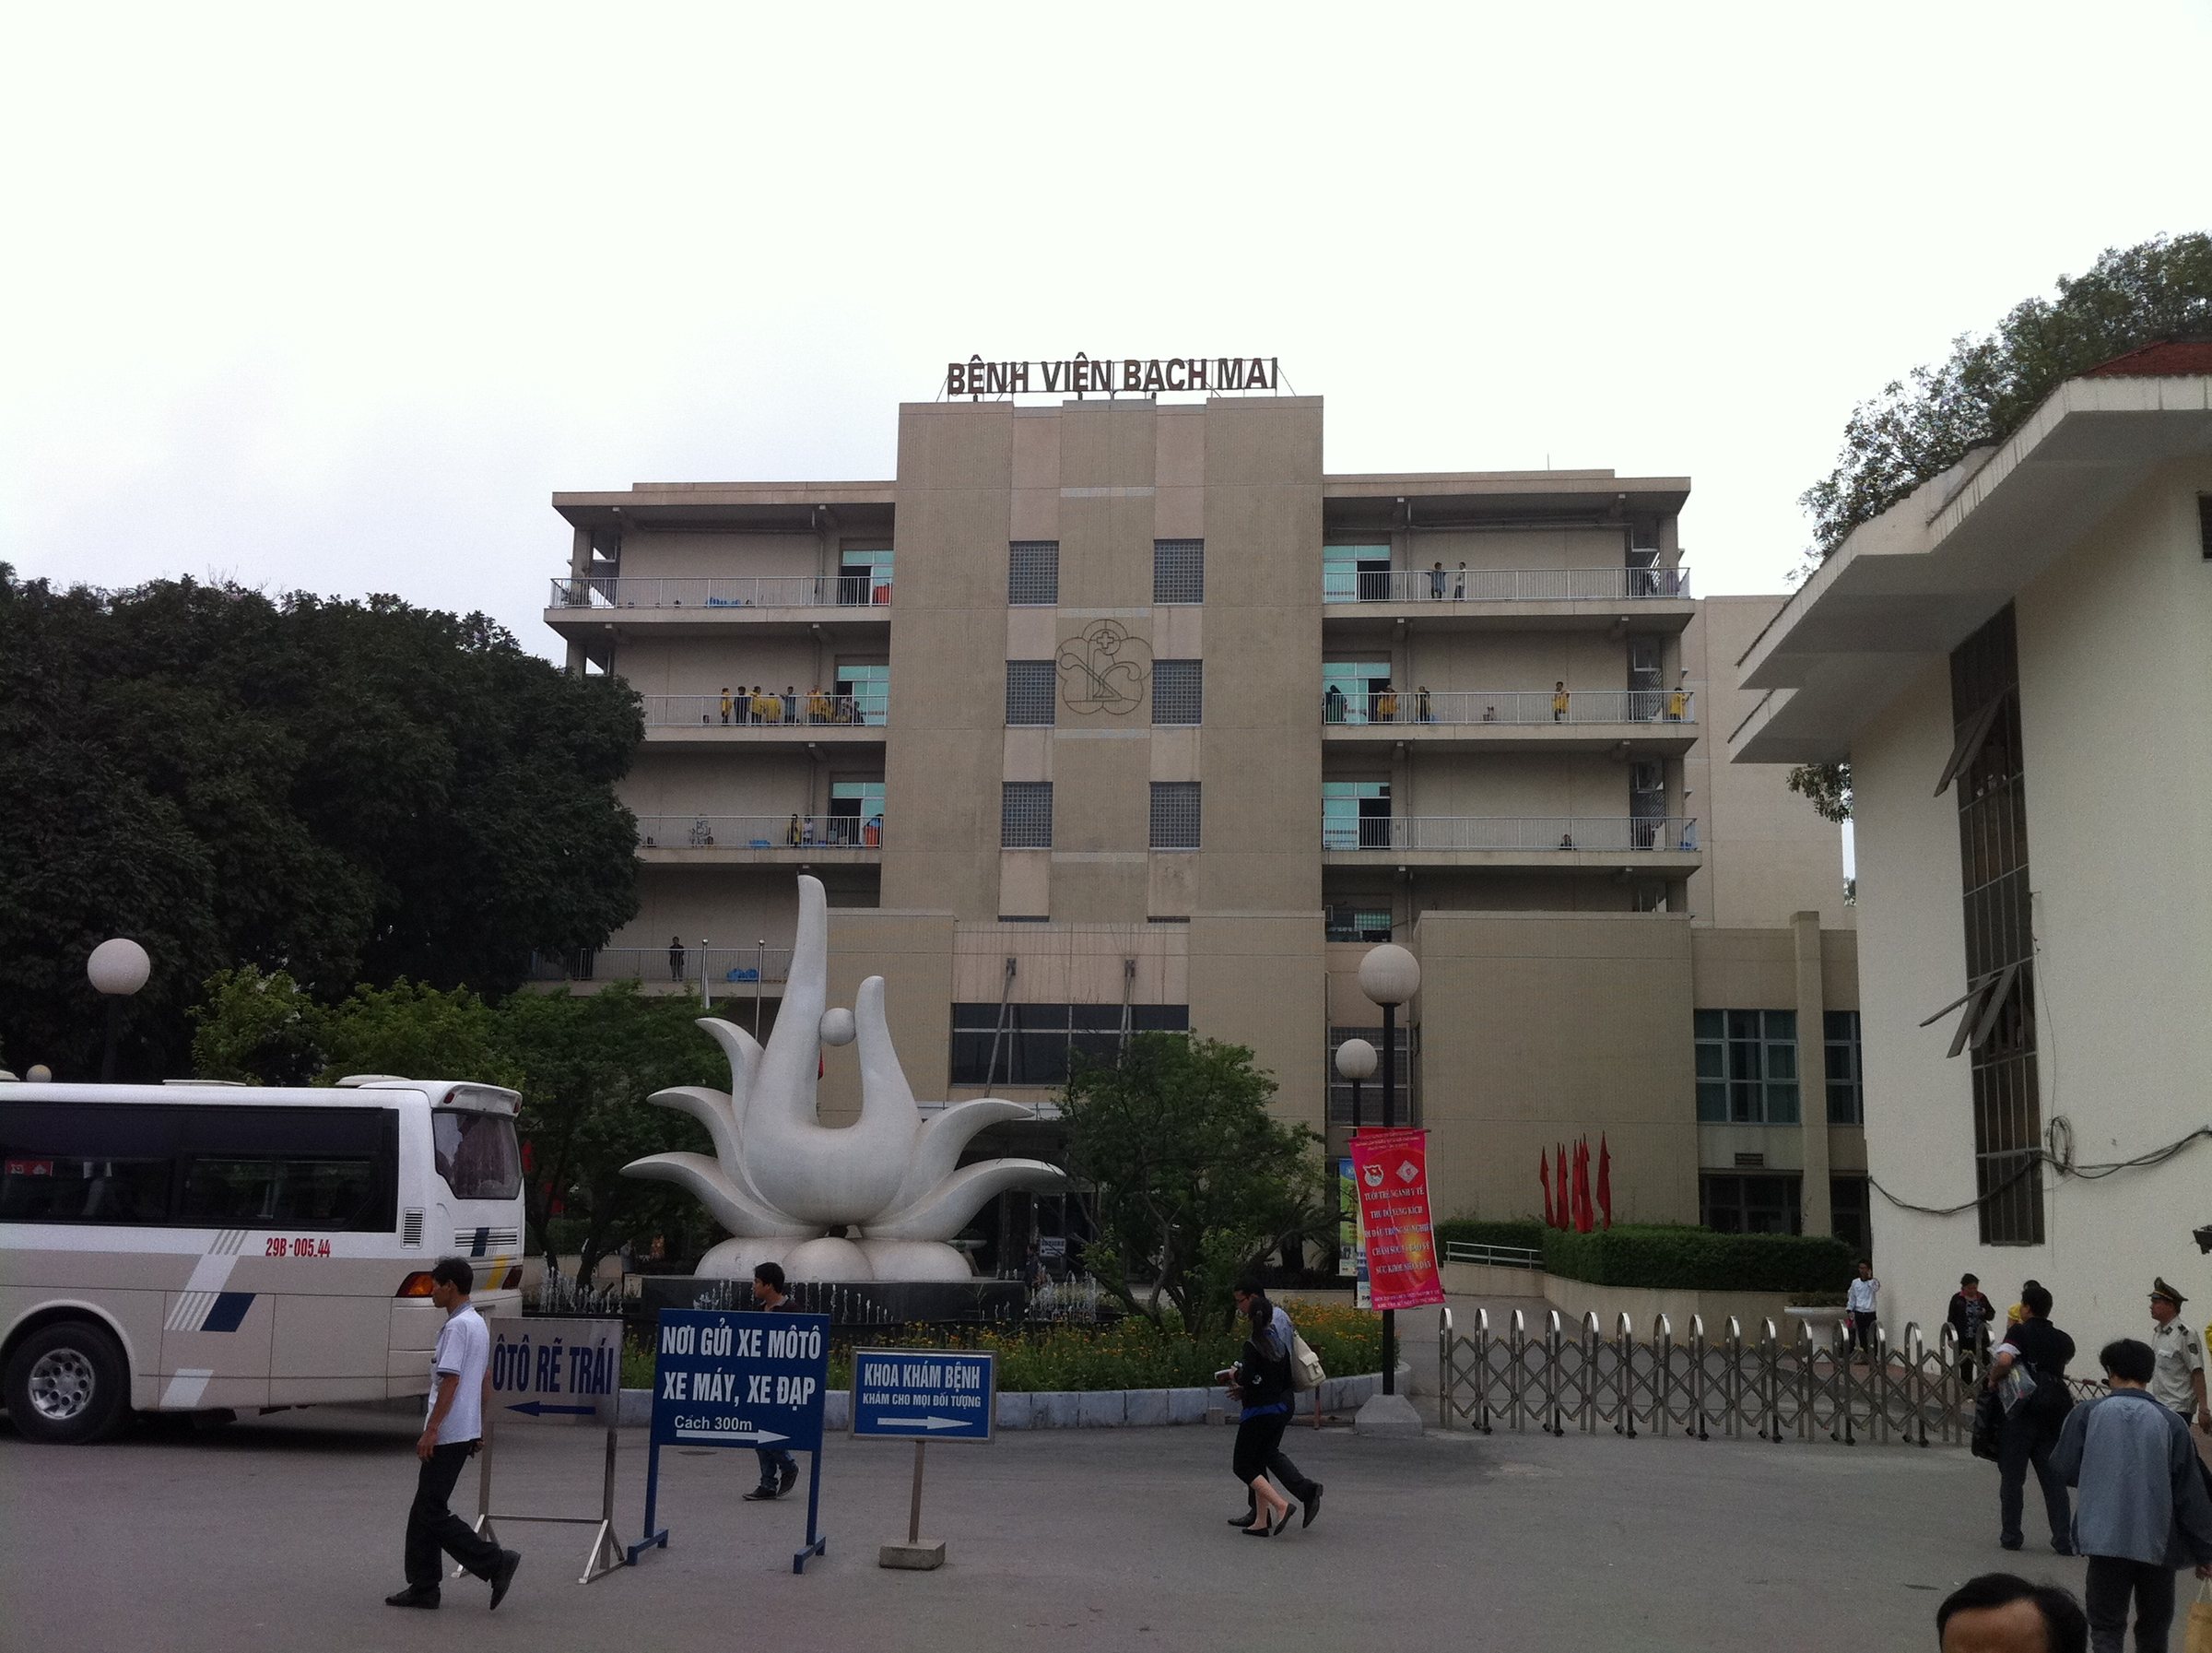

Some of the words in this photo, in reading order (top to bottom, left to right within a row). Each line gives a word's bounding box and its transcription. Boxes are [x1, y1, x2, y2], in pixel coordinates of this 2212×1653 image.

[948, 354, 1029, 402] BỆNH
[1041, 352, 1112, 401] VIỆN
[1124, 359, 1206, 399] BẠCH
[1218, 358, 1277, 389] MAI
[662, 1324, 696, 1355] NƠI
[700, 1317, 733, 1356] GỬI
[736, 1328, 762, 1358] XE
[767, 1325, 821, 1360] MÔTÔ
[493, 1333, 531, 1392] ÔTÔ
[535, 1337, 563, 1393] RẼ
[569, 1338, 614, 1395] TRÁI
[864, 1363, 900, 1387] KHOA
[903, 1360, 941, 1388] KHÁM
[945, 1361, 980, 1392] BỆNH
[663, 1371, 688, 1400] XE
[692, 1367, 740, 1407] MÁY,
[747, 1375, 772, 1404] XE
[776, 1376, 816, 1411] ĐẠP
[863, 1390, 890, 1405] KHÁM
[892, 1393, 911, 1406] CHO
[912, 1394, 931, 1409] MỌI
[950, 1394, 981, 1410] TƯỢNG
[675, 1413, 710, 1429] Cách
[714, 1416, 752, 1431] 300m
